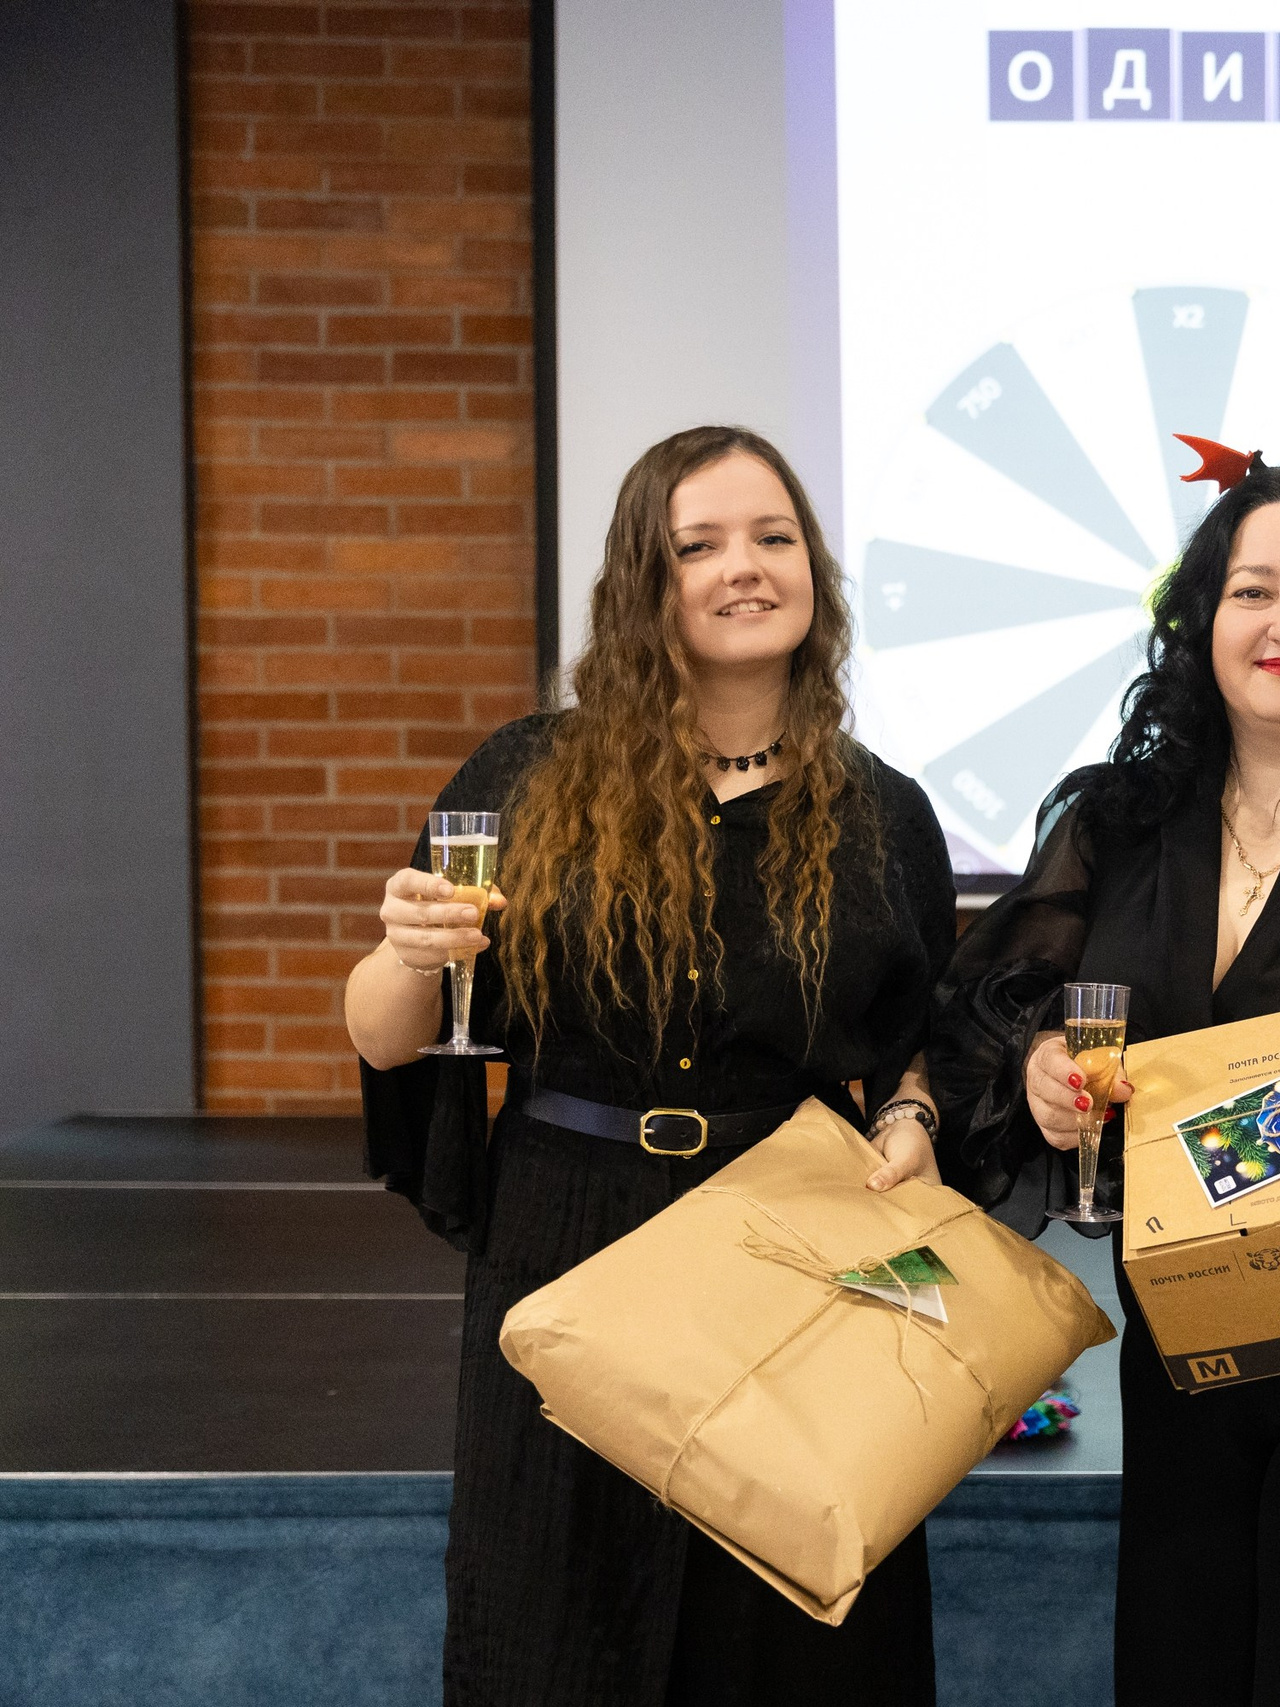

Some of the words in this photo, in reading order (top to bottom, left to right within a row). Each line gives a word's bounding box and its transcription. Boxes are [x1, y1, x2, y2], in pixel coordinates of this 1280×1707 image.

[956, 376, 1003, 421] 750
[1228, 1057, 1259, 1071] ПОЧТА
[1150, 1274, 1186, 1287] ПОЧТА
[1188, 1265, 1232, 1280] РОССИИ
